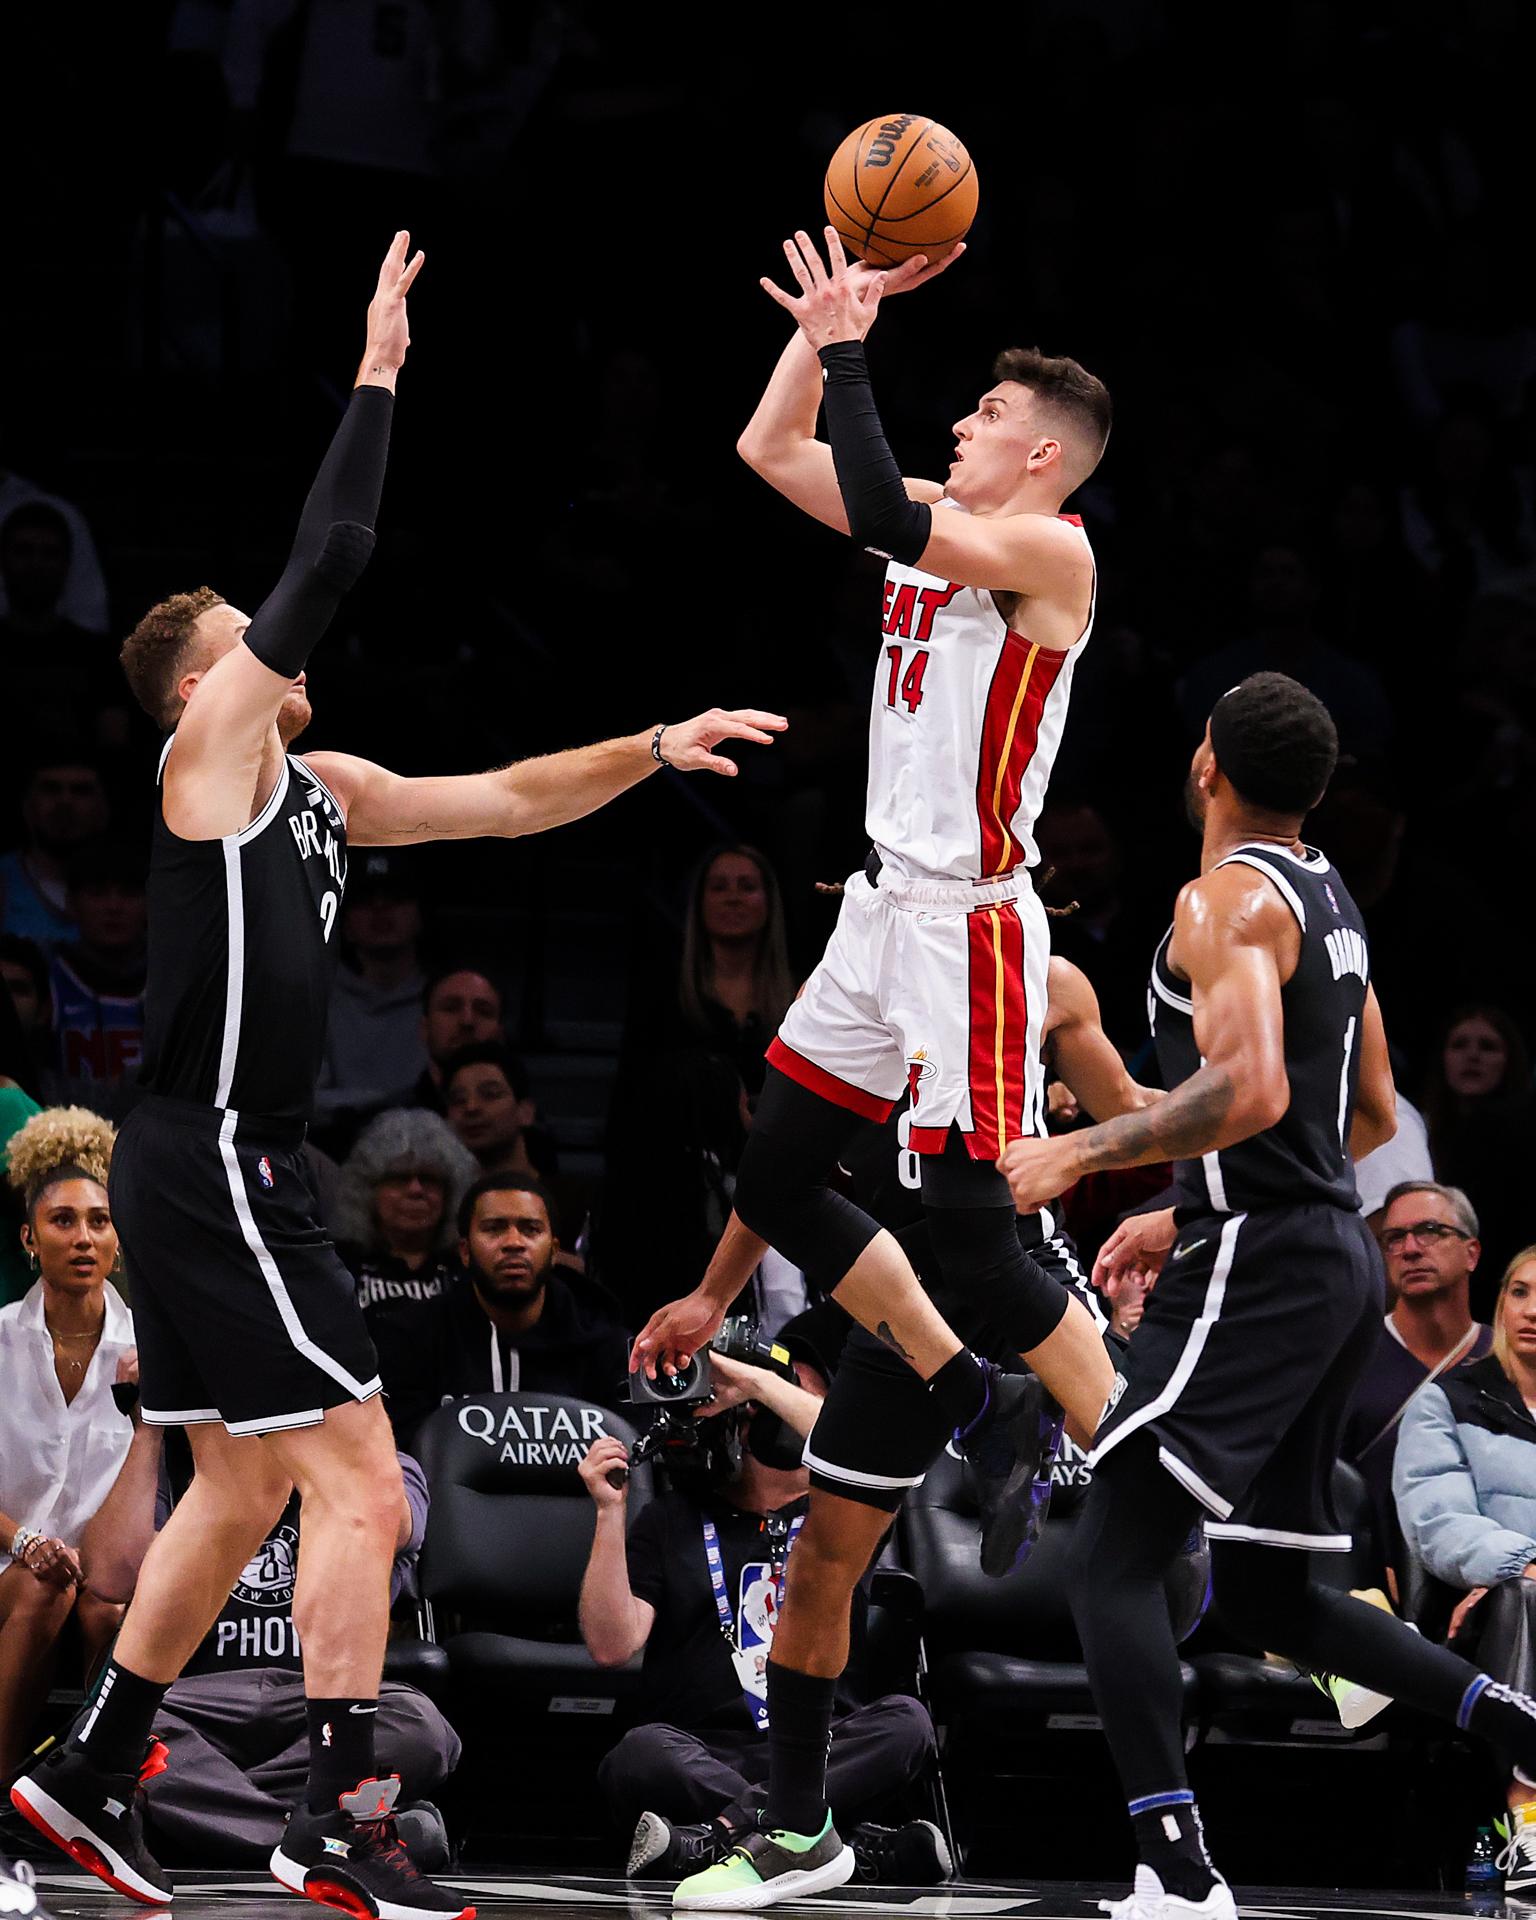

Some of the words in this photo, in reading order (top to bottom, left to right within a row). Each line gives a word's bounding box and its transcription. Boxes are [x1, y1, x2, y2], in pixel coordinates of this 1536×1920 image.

[882, 579, 966, 642] EAT
[886, 645, 930, 714] 14
[1337, 1016, 1356, 1158] 1
[458, 1404, 609, 1446] QATAR
[500, 1442, 591, 1465] AIRWA
[217, 1616, 301, 1657] PHOT
